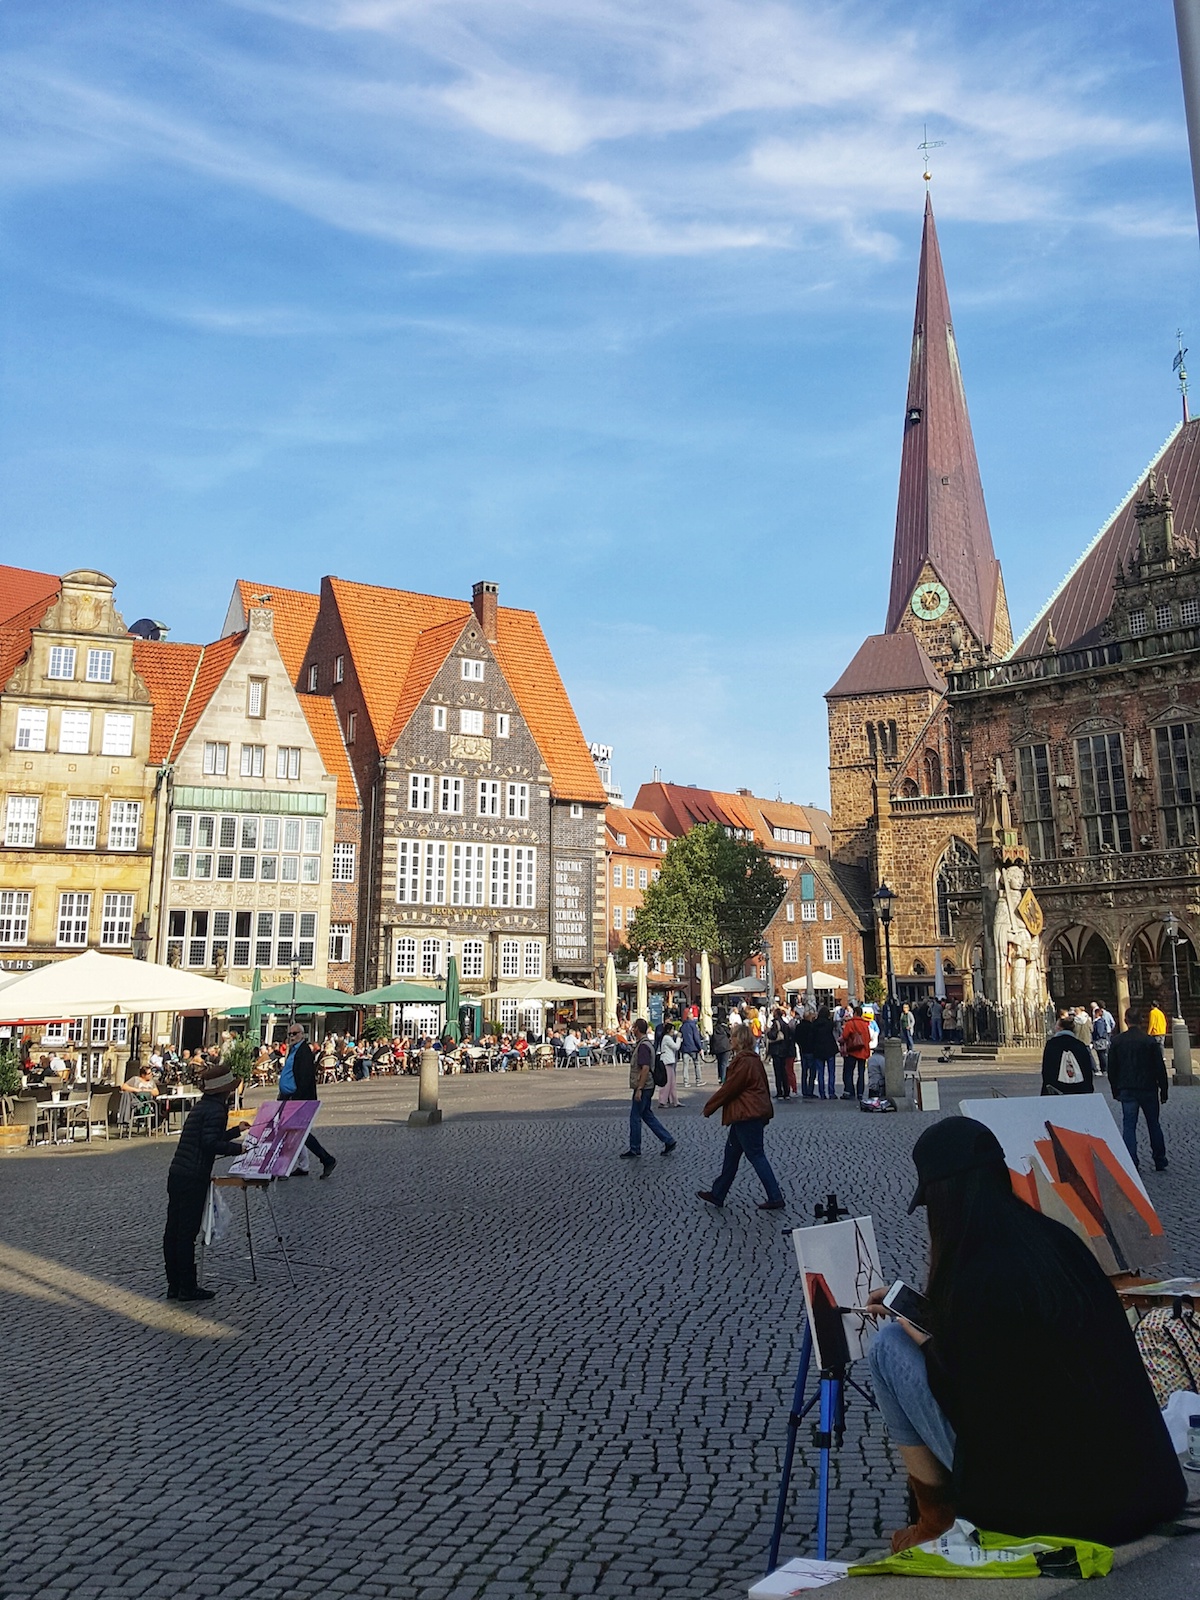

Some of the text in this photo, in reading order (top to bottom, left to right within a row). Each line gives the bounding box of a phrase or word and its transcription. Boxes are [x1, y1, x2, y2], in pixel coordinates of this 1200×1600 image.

[587, 742, 614, 760] ADT
[555, 860, 582, 872] GEDENKE
[555, 872, 568, 884] DER
[555, 897, 578, 909] DIE DAS
[555, 910, 586, 921] SCHICKSAL
[555, 922, 582, 934] UNSERER
[555, 935, 587, 947] TRENNUNG
